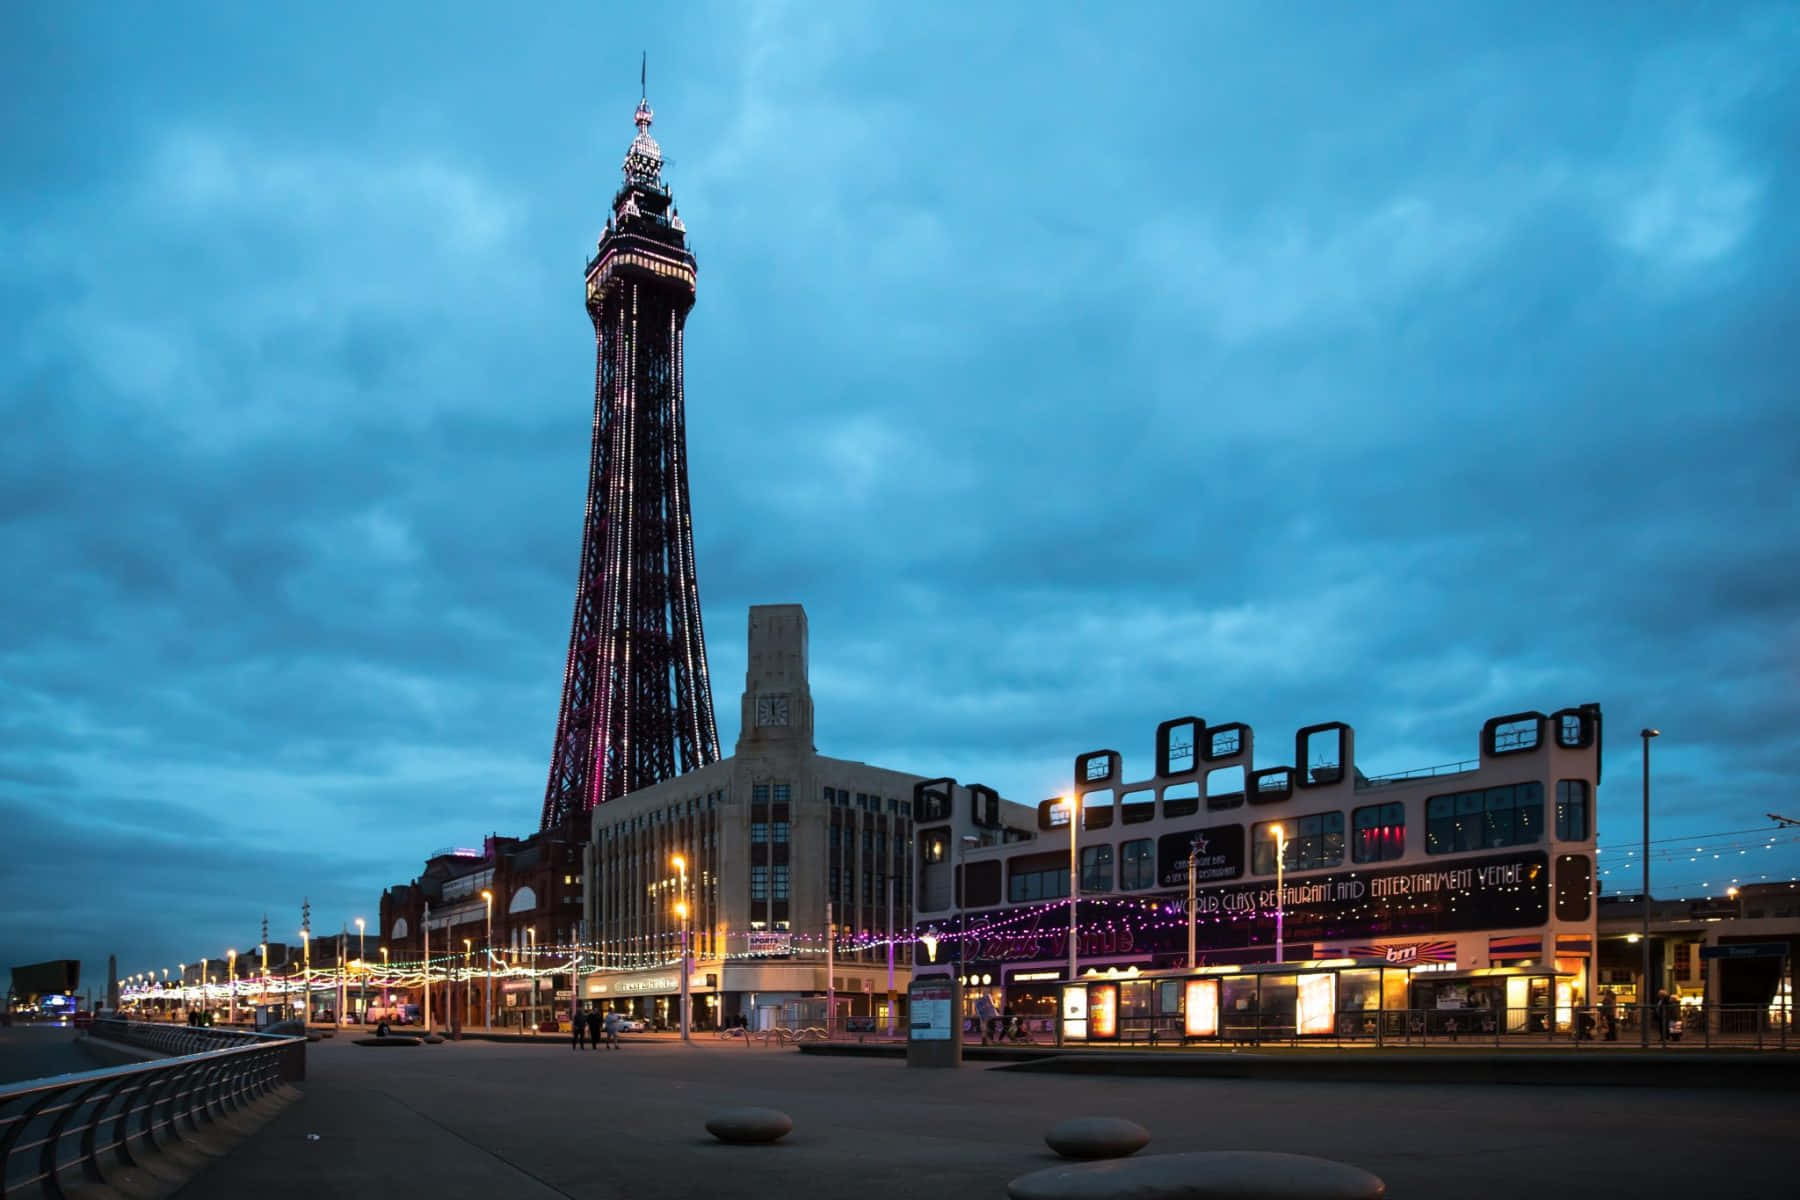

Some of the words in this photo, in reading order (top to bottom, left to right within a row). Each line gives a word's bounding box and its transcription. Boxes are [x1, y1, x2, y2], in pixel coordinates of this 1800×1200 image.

[1222, 891, 1256, 913] CLASS
[1260, 883, 1333, 909] RETAURANT
[1336, 880, 1366, 900] AND
[1370, 869, 1473, 897] ENTERTAINMENT
[1477, 863, 1525, 888] VENUE
